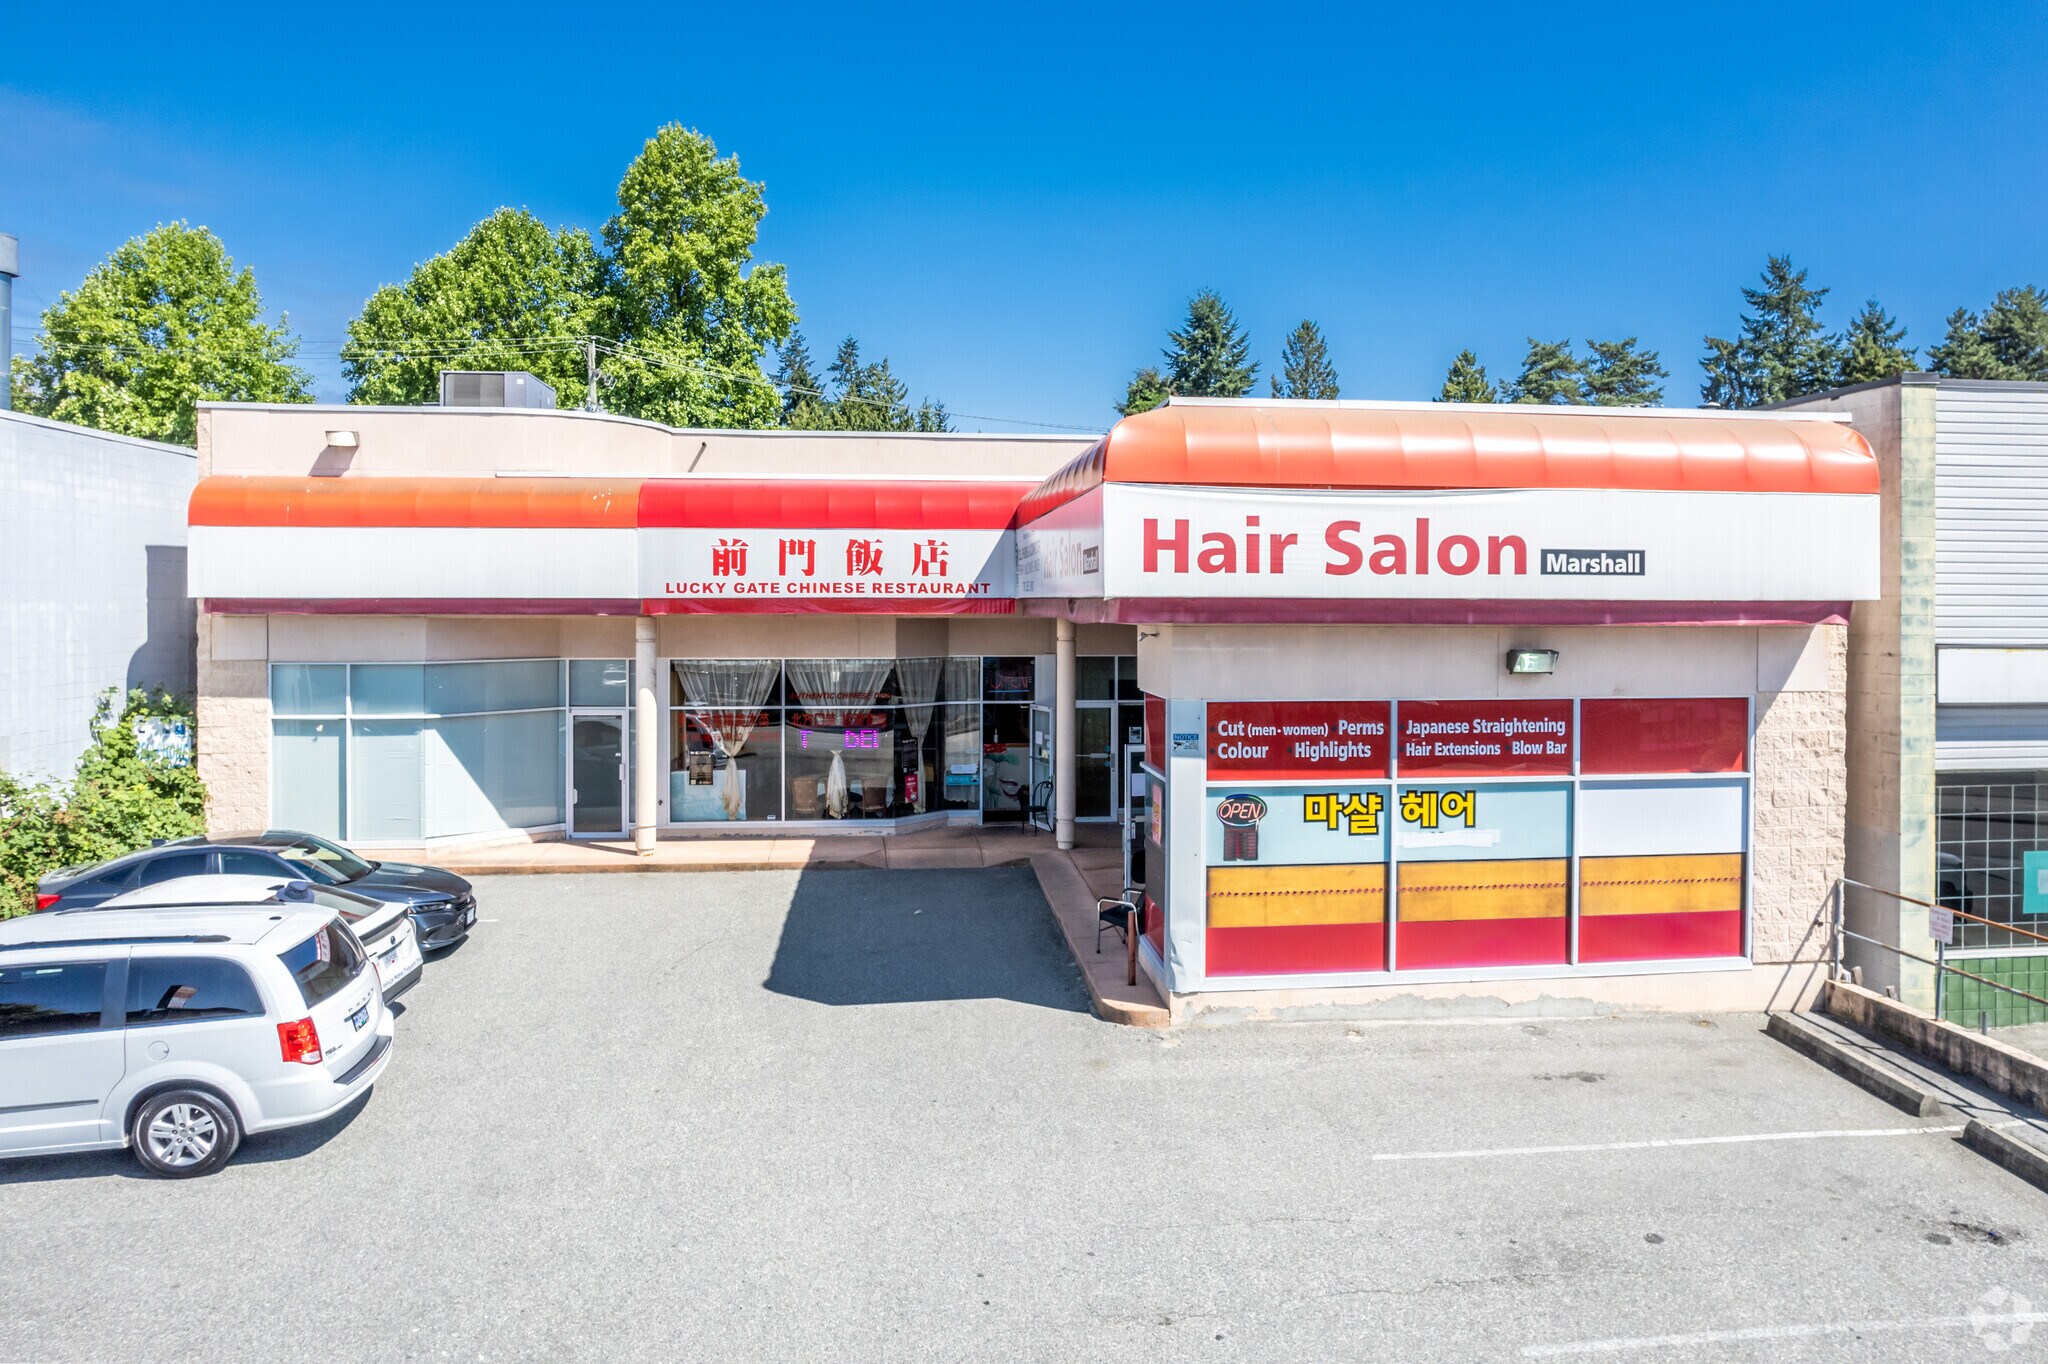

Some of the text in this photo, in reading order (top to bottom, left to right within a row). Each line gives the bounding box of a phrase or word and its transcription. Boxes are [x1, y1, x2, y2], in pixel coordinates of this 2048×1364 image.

[1143, 515, 1528, 576] Hair Salon
[711, 538, 949, 577] 前門飯店
[1545, 551, 1641, 575] Marshall
[665, 582, 991, 594] LUCKY GATE CHINESE RESTAURANT
[1217, 720, 1245, 737] Cut
[1338, 719, 1385, 736] Perms
[1406, 717, 1566, 738] Japanese Straightening
[1217, 742, 1269, 759] Colour
[1294, 741, 1372, 762] Highlights
[1405, 740, 1568, 757] Hair Extensions Blow Bar
[1219, 803, 1262, 819] OPEN
[1303, 789, 1477, 837] 마샬 헤어
